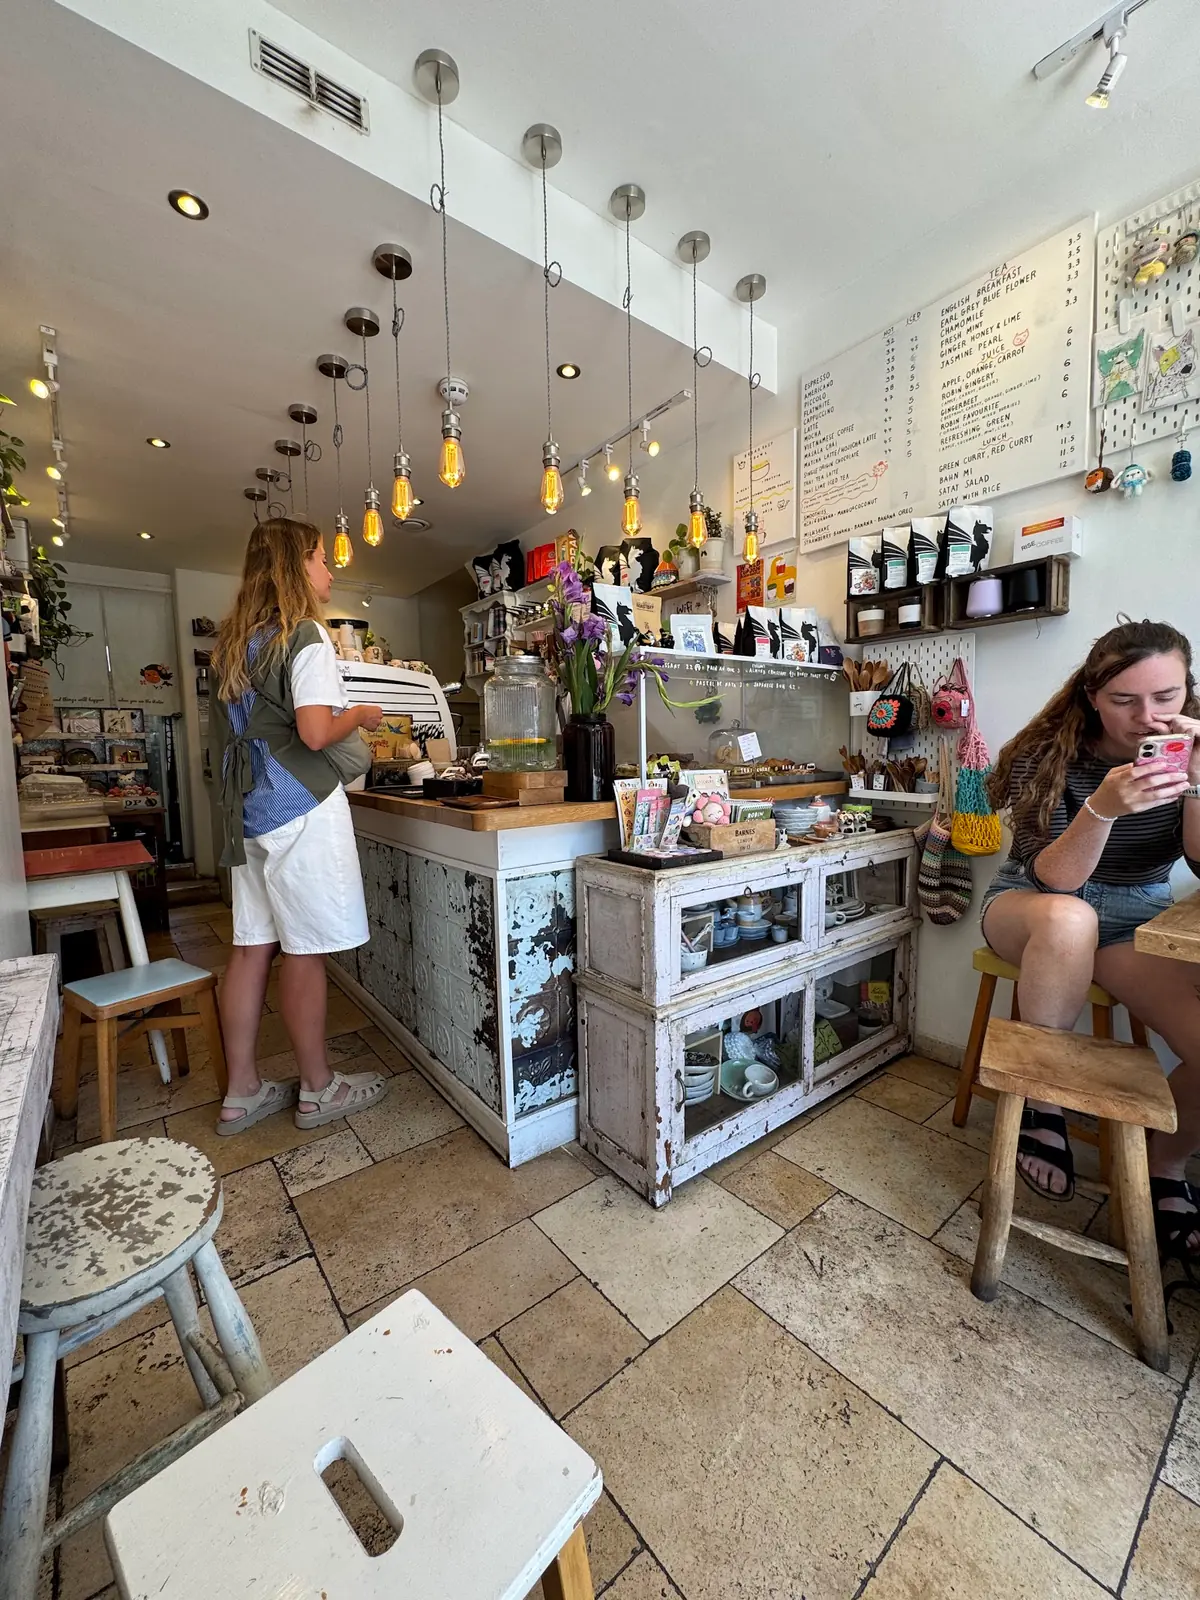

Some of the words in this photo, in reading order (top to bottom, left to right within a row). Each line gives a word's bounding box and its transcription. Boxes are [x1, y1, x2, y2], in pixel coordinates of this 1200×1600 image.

[1068, 232, 1081, 246] 3.5
[1068, 246, 1080, 259] 3.5
[990, 263, 1008, 279] TEA
[1068, 258, 1080, 269] 3.3
[1067, 270, 1078, 281] 3.3
[941, 295, 970, 317] ENGLISH
[977, 266, 1021, 297] BREAKFAST
[941, 313, 958, 328] EARL
[961, 301, 980, 316] GREY
[983, 289, 1001, 305] BLUE
[1006, 270, 1036, 294] FLOWER
[1065, 296, 1077, 307] 3.3
[906, 312, 921, 325] ICED
[940, 309, 984, 337] CHAMOMILE
[884, 326, 894, 336] HOT
[940, 340, 966, 358] GINGER
[971, 325, 994, 342] HONEY
[1004, 311, 1021, 326] LIME
[941, 332, 962, 348] FRESH
[966, 321, 983, 334] MINT
[1067, 326, 1073, 334] 6
[1066, 338, 1072, 347] 6
[940, 348, 973, 369] JASMINE
[978, 334, 1003, 351] PEARL
[981, 344, 1005, 361] JUICE
[942, 376, 964, 390] APPLE,
[966, 361, 996, 379] ORANGE,
[997, 346, 1026, 364] CARROT
[1063, 359, 1071, 367] 6
[805, 372, 830, 391] ESPRESSO
[1063, 373, 1069, 381] 6
[804, 380, 834, 400] AMERICANO
[942, 386, 962, 400] ROBIN
[965, 372, 995, 389] GINGERY
[1061, 389, 1068, 398] 6
[804, 392, 826, 408] PICCOLO
[908, 396, 914, 404] 5
[940, 395, 978, 416] GINGERBEET
[803, 406, 834, 425] CAPPUCCINO
[804, 399, 830, 417] FLATWHITE
[907, 406, 913, 414] 5
[940, 417, 960, 430] ROBIN
[963, 401, 1000, 421] FAVOURITE
[804, 422, 818, 434] LATTE
[907, 417, 913, 425] 5
[804, 430, 821, 442] MOCHA
[940, 425, 980, 445] REFRESHING
[987, 413, 1011, 427] GREEN
[804, 432, 834, 451] VIETNAMESE
[837, 424, 854, 436] COFFEE
[982, 432, 1007, 447] LUNCH
[1061, 435, 1074, 445] 11.5
[804, 447, 823, 459] MASALA
[826, 441, 838, 450] CHAI
[804, 457, 821, 468] MATCHA
[863, 433, 877, 444] LATTE
[939, 460, 959, 472] GREEN
[963, 451, 990, 465] CURRY,
[991, 444, 1005, 455] RED
[1009, 435, 1033, 449] CURRY
[1060, 446, 1075, 456] 11.5
[804, 468, 818, 479] SINGLE
[820, 461, 834, 471] ORIGIN
[835, 450, 859, 464] CHOCOLATE
[1060, 460, 1067, 468] 12
[826, 468, 839, 478] LATTE
[939, 472, 959, 484] BAHN
[963, 468, 973, 477] MI
[815, 483, 826, 491] LIME
[827, 478, 838, 486] ICED
[965, 474, 989, 489] SALAD
[903, 491, 908, 499] 7
[938, 497, 958, 509] SATAY
[962, 491, 978, 500] WITH
[982, 483, 1001, 495] RICE
[803, 533, 831, 546] STRAWBERRY
[833, 527, 851, 536] BANANA
[854, 519, 873, 530] BANANA
[878, 513, 896, 523] BANANA
[898, 507, 913, 516] OREO
[1021, 540, 1036, 551] RISE
[1036, 536, 1064, 548] COFFEE
[735, 828, 756, 837] BARNES
